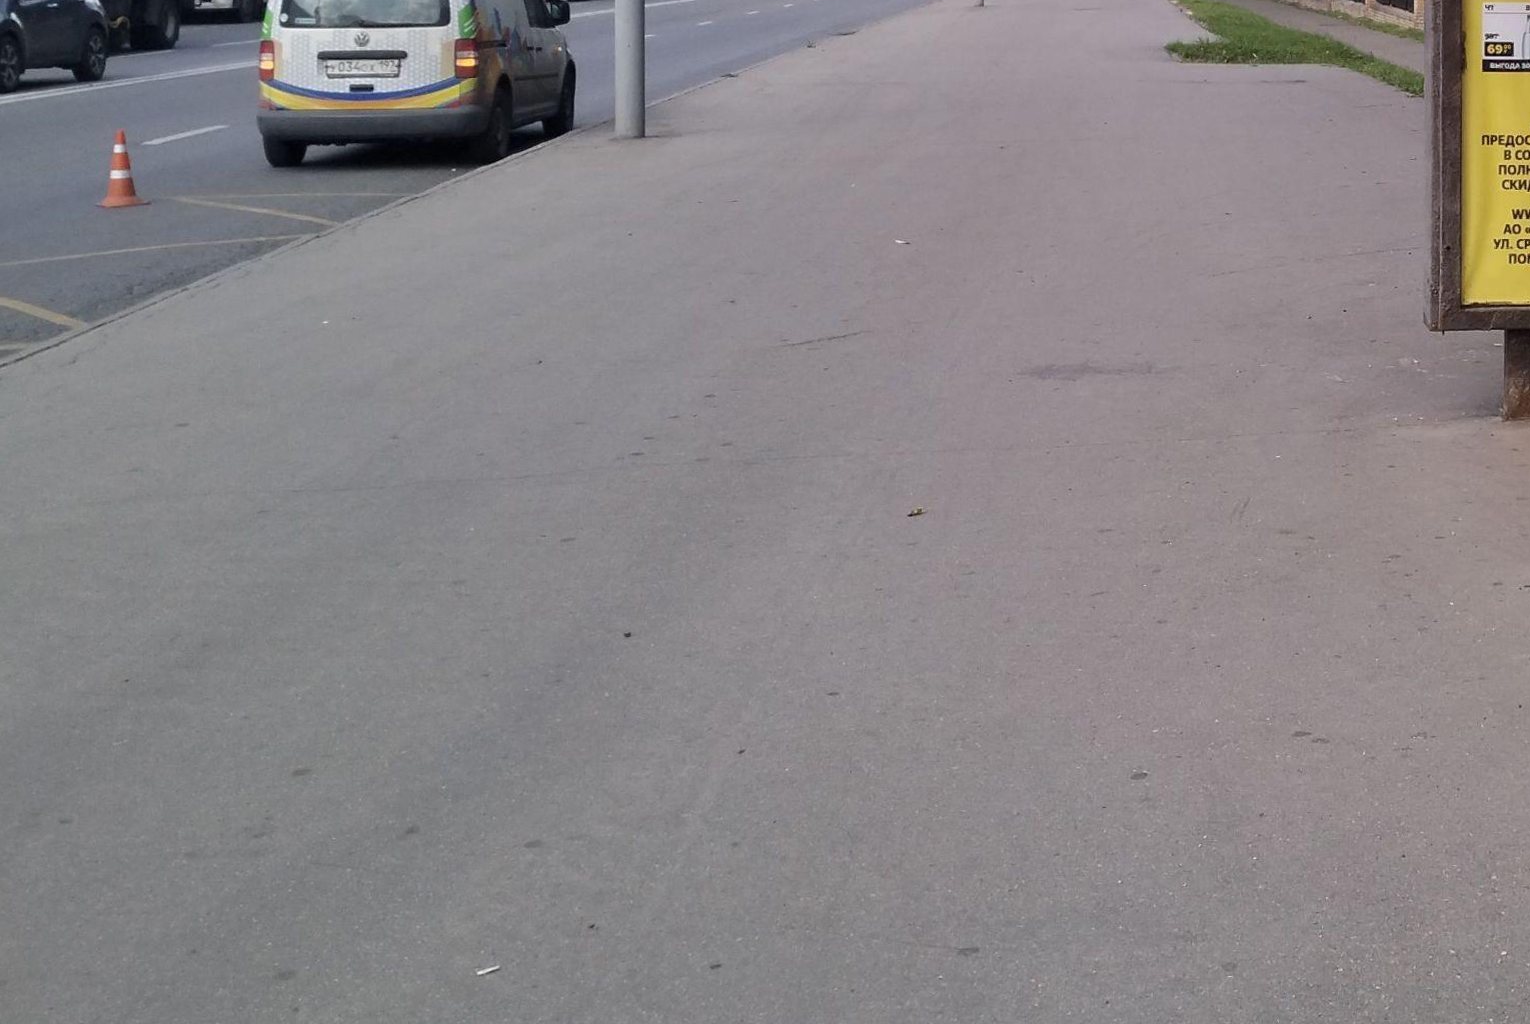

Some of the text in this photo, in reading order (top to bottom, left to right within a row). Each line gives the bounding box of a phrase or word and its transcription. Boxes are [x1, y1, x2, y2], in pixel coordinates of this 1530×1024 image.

[1487, 44, 1502, 54] 69
[1504, 149, 1512, 160] В
[1504, 222, 1521, 233] АО
[1494, 236, 1514, 248] УЛ.
